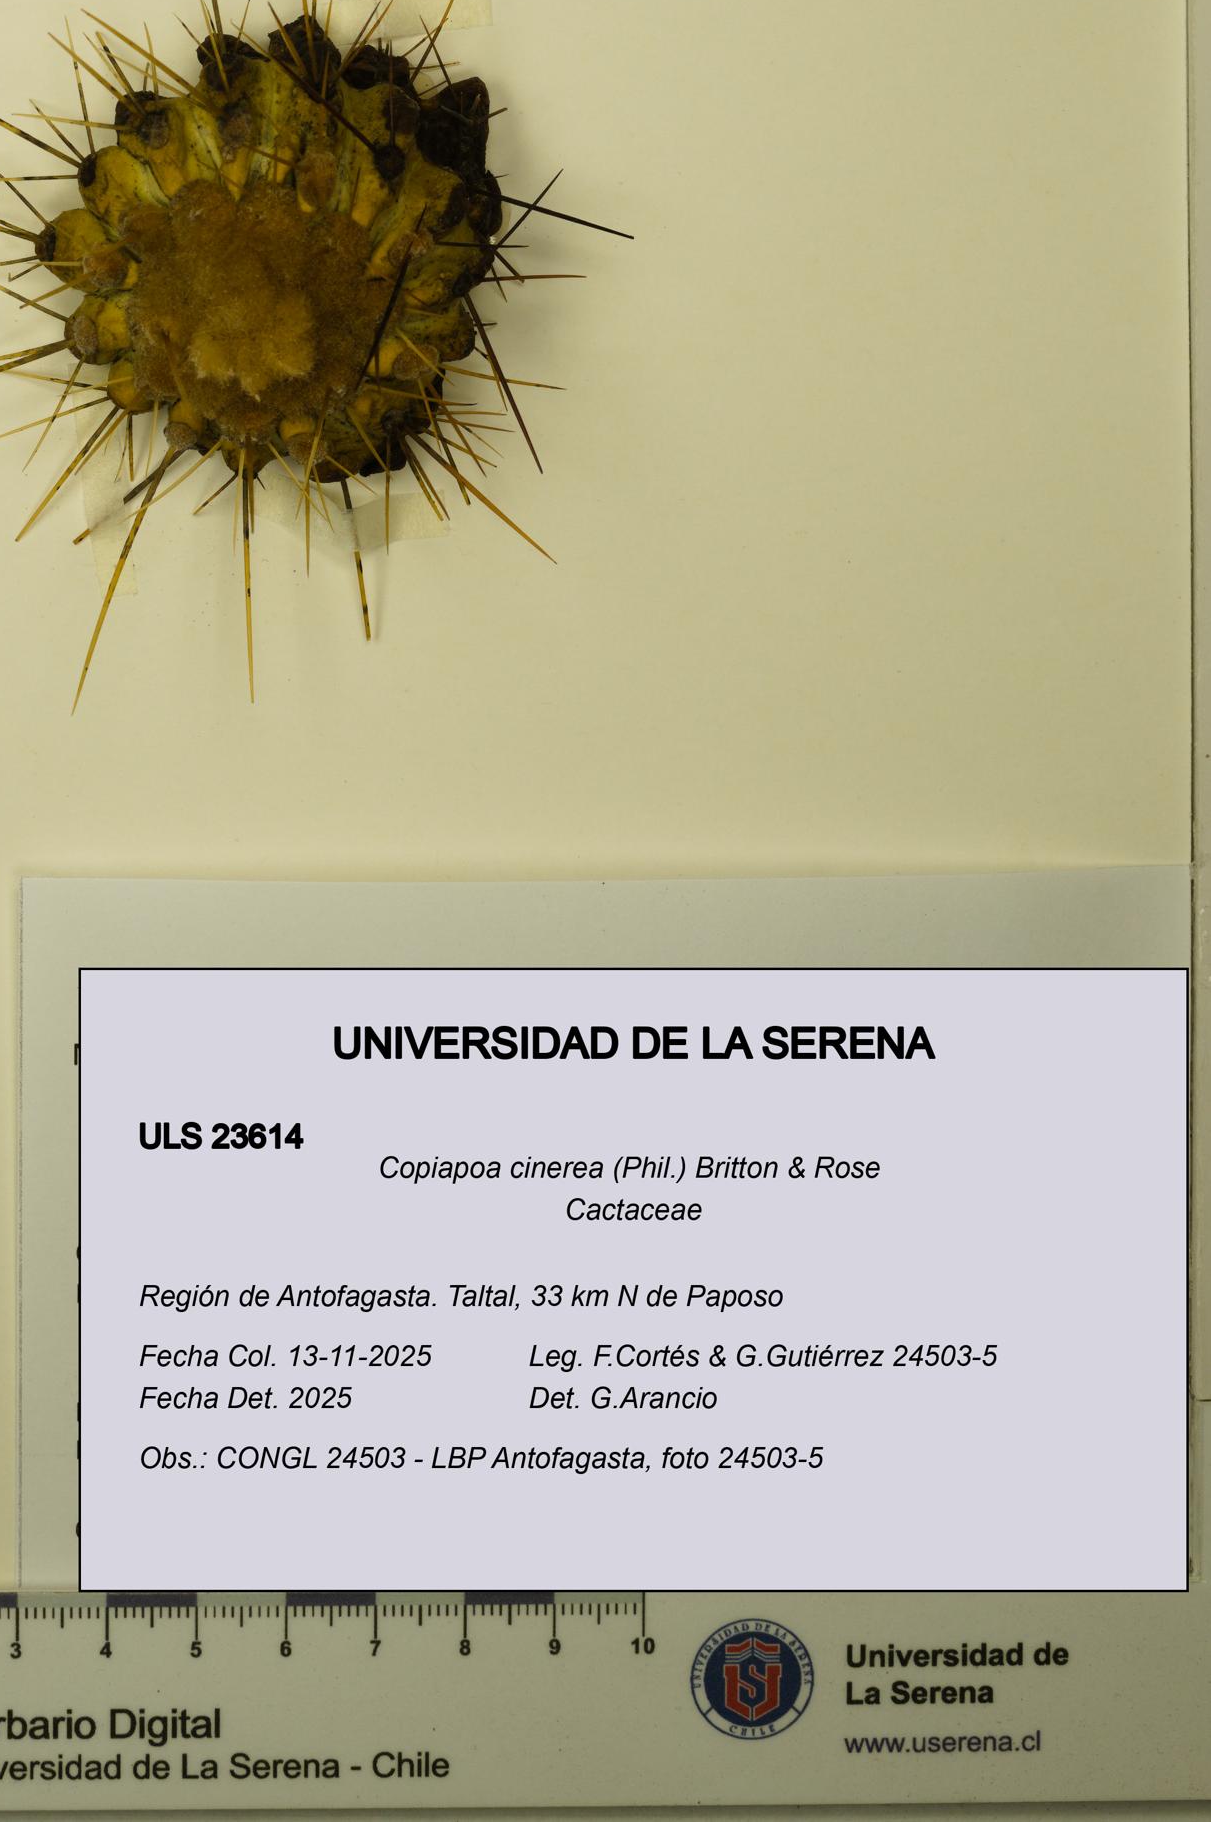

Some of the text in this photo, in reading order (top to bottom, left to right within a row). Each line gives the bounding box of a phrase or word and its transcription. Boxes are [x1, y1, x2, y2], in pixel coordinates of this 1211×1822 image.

[9, 1641, 22, 1660] 3
[99, 1640, 113, 1659] 4
[189, 1640, 203, 1659] 5
[279, 1639, 292, 1658] 6
[369, 1638, 382, 1657] 7
[458, 1638, 472, 1657] 8
[548, 1637, 562, 1656] 9
[630, 1636, 656, 1655] 10
[692, 1621, 813, 1689] UNIVERSIDAD DE LA SERENA
[846, 1641, 1070, 1669] Universidad de
[846, 1680, 994, 1706] La Serena
[109, 1707, 221, 1748] Digital
[728, 1724, 777, 1737] CHILE
[844, 1729, 1041, 1754] www.userena.cl
[132, 1753, 171, 1780] de
[181, 1753, 219, 1780] La
[229, 1752, 340, 1780] Serena
[372, 1751, 450, 1779] Chile
